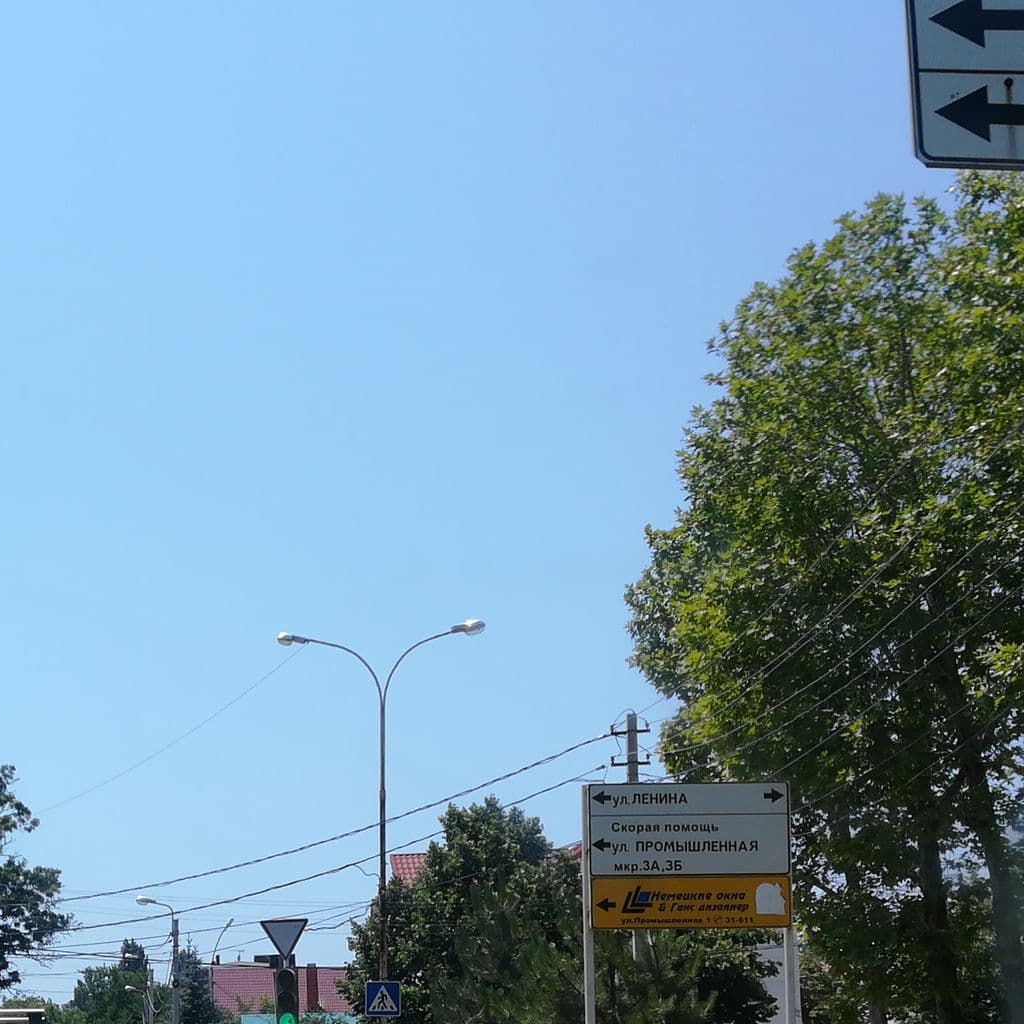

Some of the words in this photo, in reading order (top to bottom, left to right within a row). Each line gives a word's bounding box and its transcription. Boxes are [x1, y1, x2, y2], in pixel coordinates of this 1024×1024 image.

[632, 792, 688, 805] ЛЕНИНА
[611, 822, 660, 834] Скорая
[664, 823, 719, 833] помощь
[636, 840, 759, 852] ПРОМЫШЛЕННАЯ
[716, 892, 746, 901] окна
